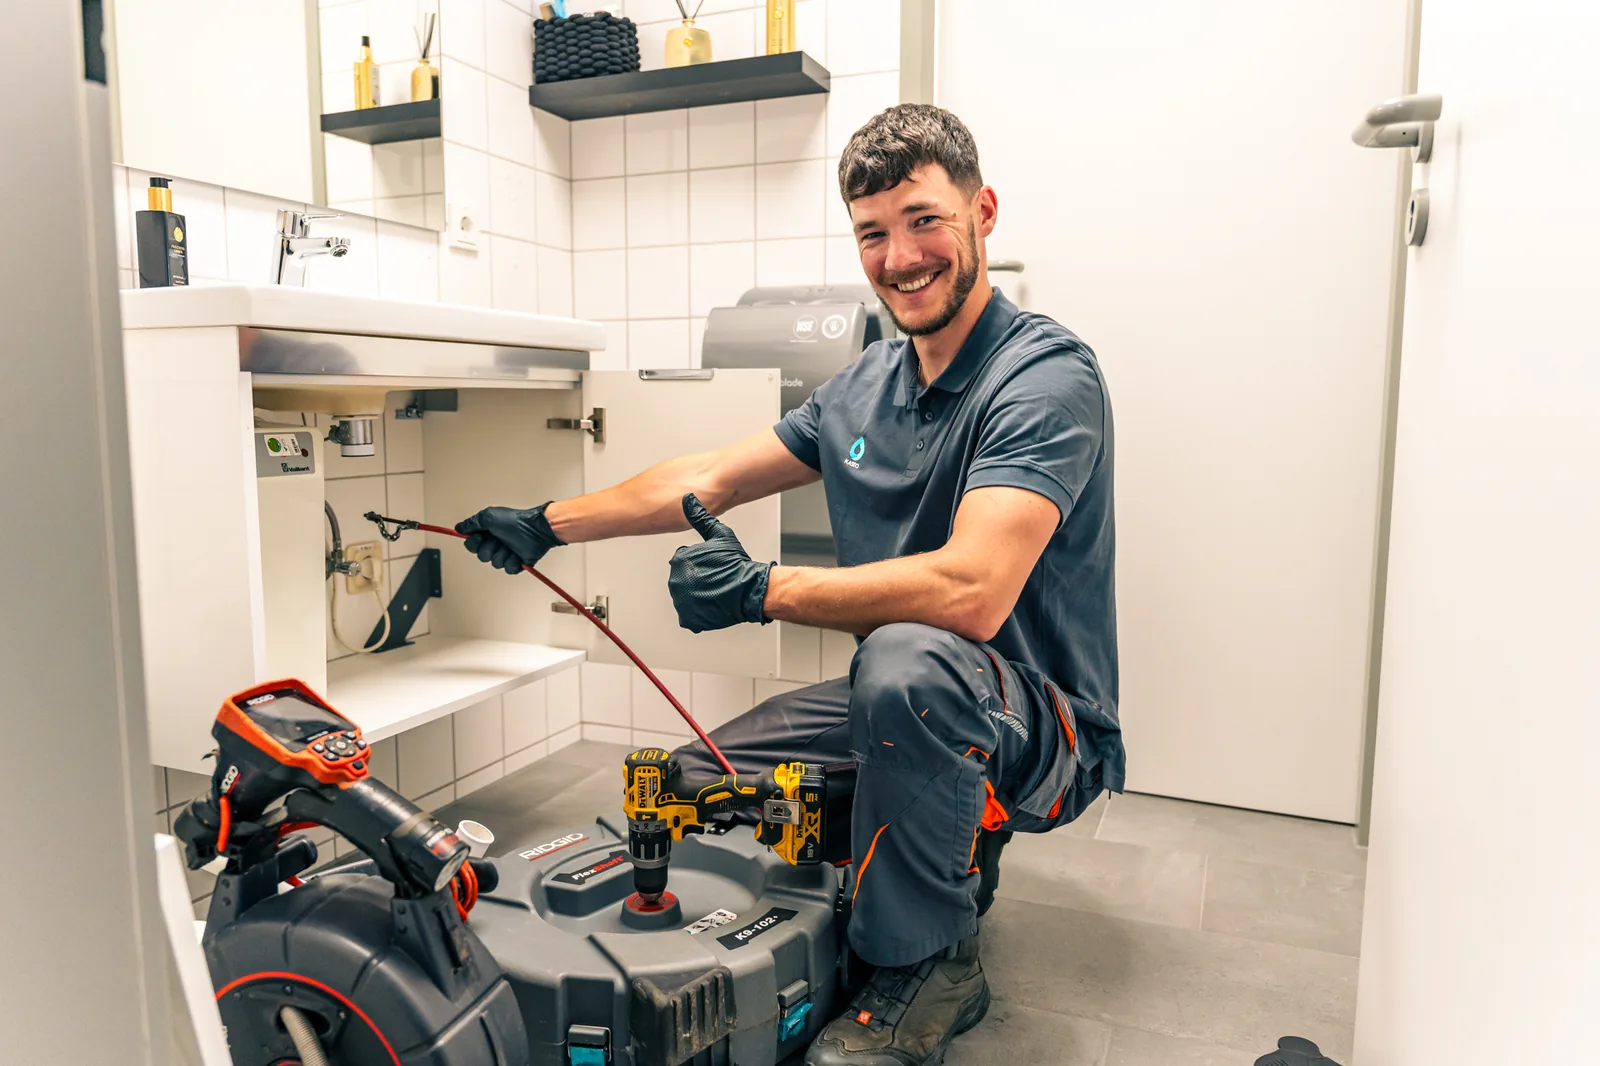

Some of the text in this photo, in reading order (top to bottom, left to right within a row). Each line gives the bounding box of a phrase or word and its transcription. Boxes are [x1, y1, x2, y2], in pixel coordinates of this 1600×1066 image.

[805, 792, 814, 802] 5
[805, 808, 821, 844] XR
[518, 833, 584, 860] RIDGID
